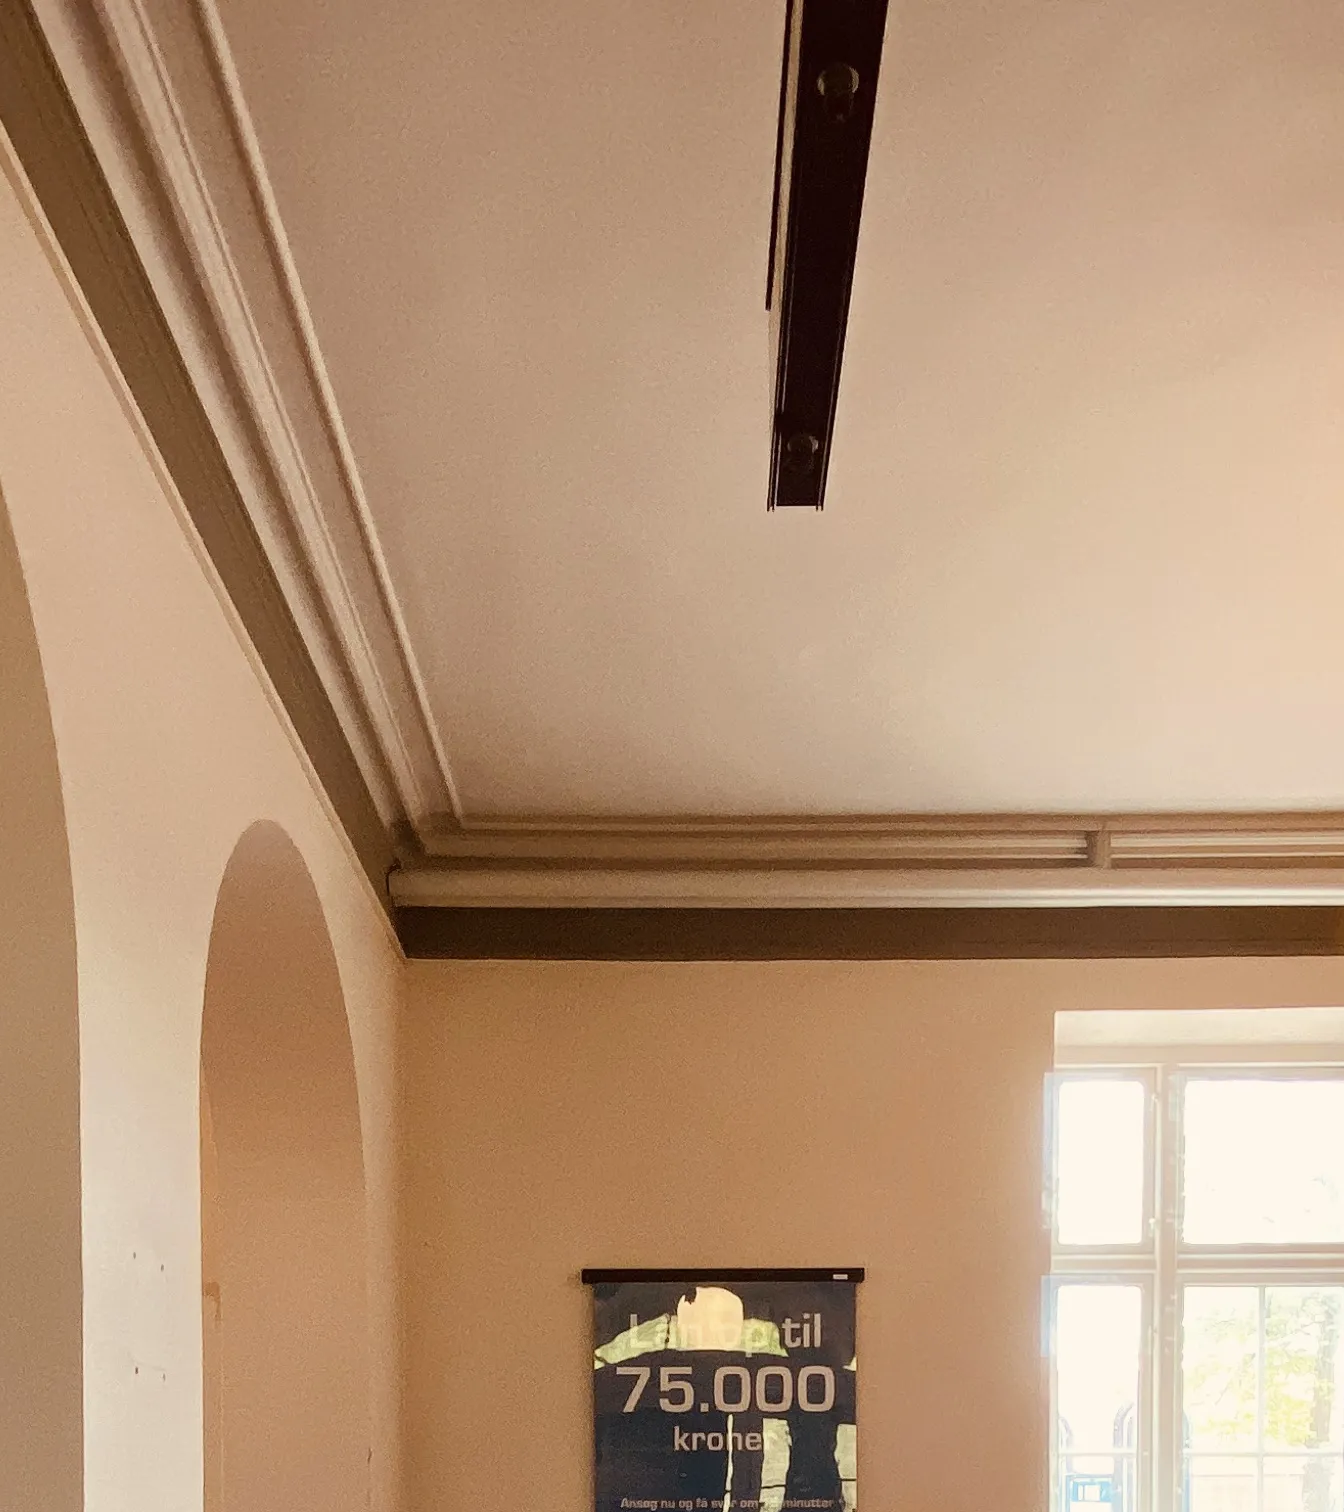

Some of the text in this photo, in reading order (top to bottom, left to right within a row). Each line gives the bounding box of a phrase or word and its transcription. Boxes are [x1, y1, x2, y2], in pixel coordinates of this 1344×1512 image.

[630, 1313, 703, 1349] Ln
[782, 1312, 822, 1349] til
[616, 1365, 835, 1413] 75.000
[673, 1425, 765, 1451] krone
[711, 1499, 737, 1510] svr
